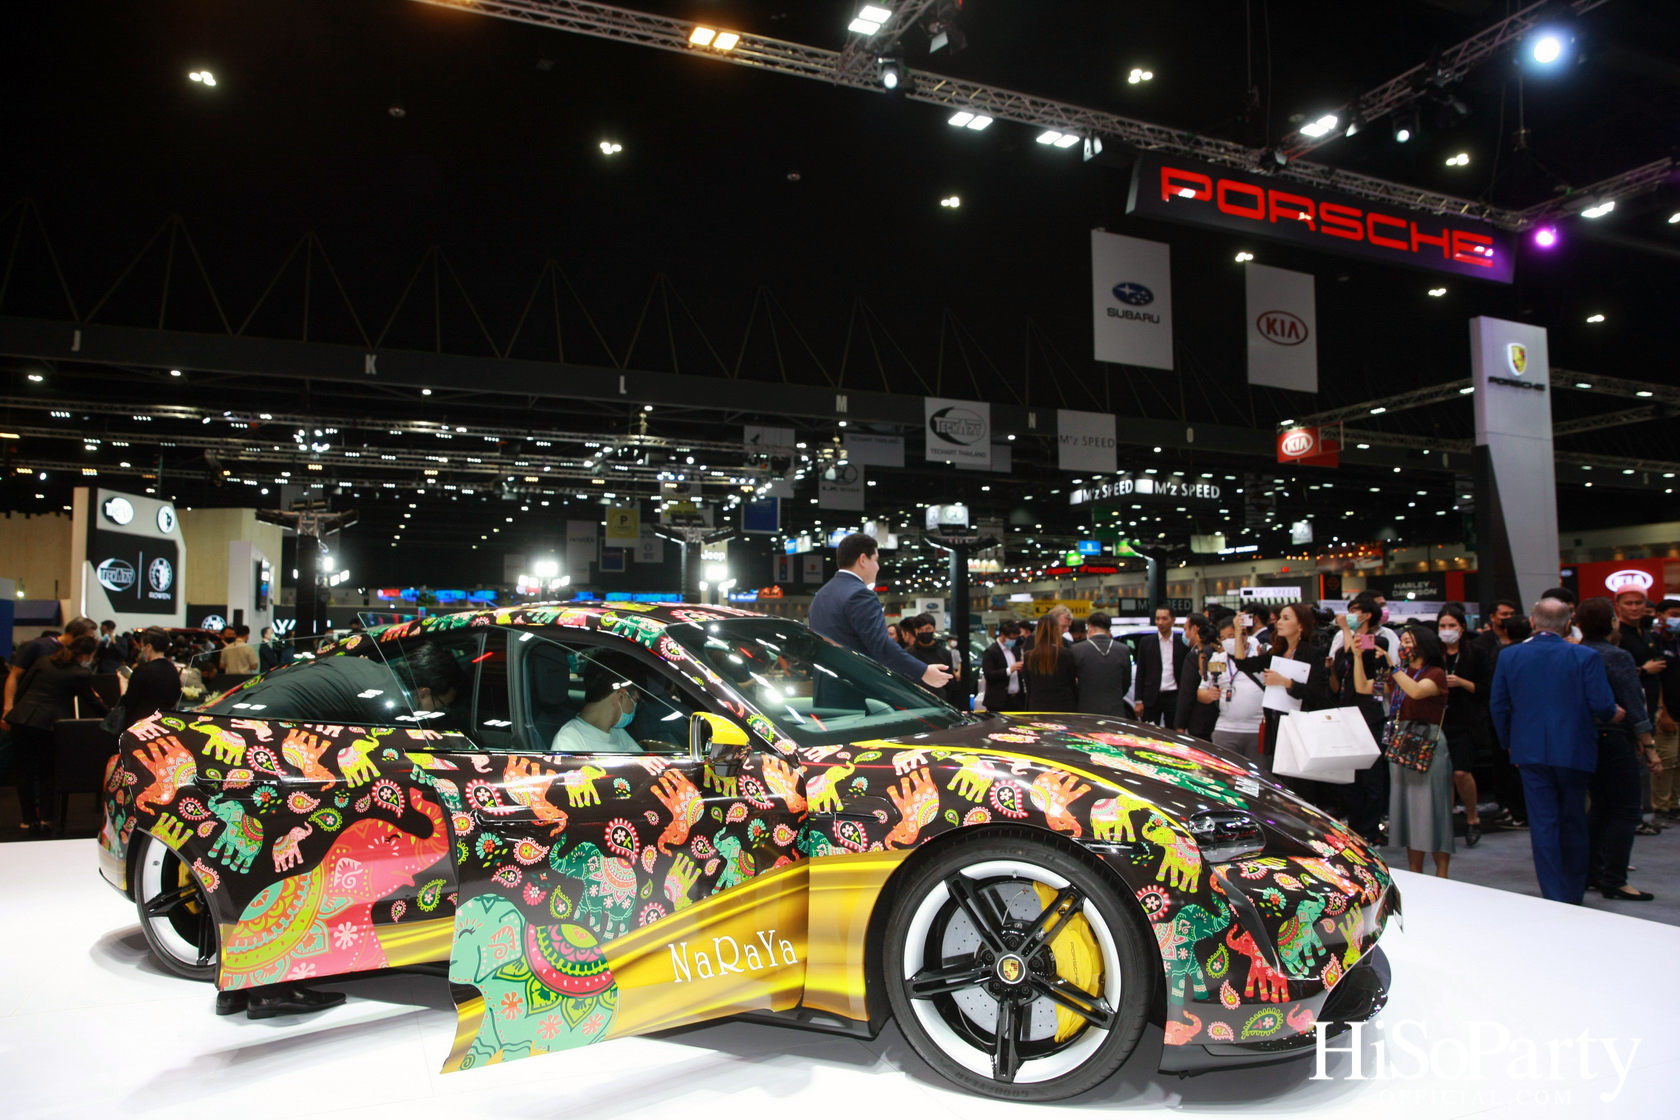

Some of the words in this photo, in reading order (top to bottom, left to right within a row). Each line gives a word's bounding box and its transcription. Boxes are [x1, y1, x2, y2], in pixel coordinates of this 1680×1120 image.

[1160, 166, 1494, 268] PORSCHE
[1106, 307, 1160, 324] SUBARU
[1265, 316, 1300, 340] KIA
[365, 354, 377, 375] K
[619, 375, 628, 395] L
[1488, 376, 1546, 391] PORSCHE
[836, 395, 848, 413] M
[1028, 412, 1037, 429] N
[1059, 435, 1079, 446] M'z
[1082, 436, 1116, 449] SPEED
[1287, 437, 1309, 452] KIA
[930, 448, 957, 456] TECHART
[958, 450, 987, 458] THAILAND
[1083, 487, 1100, 502] M'z
[1102, 479, 1133, 499] SPEED
[1154, 481, 1178, 496] M'z
[1181, 483, 1220, 499] SPEED
[700, 549, 726, 562] Jeep
[667, 929, 798, 983] NaRaYa
[1070, 941, 1080, 985] PORSCHE
